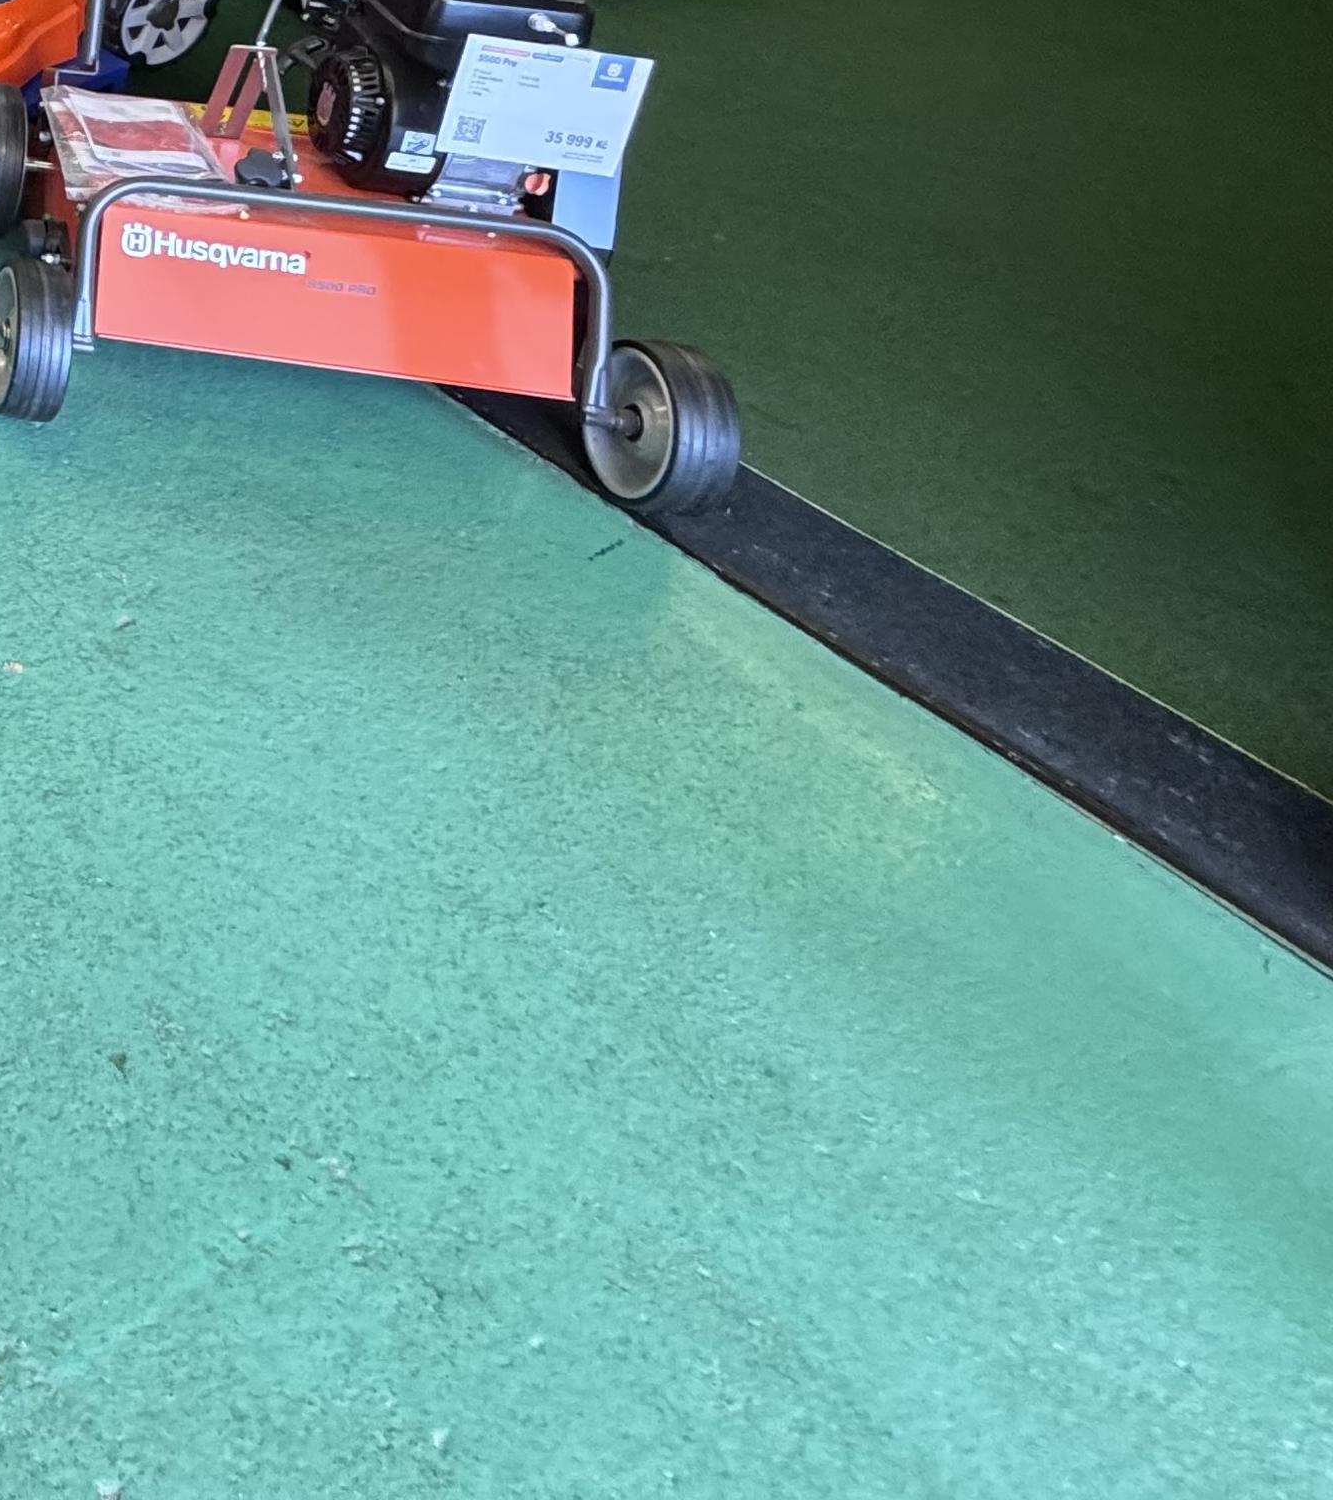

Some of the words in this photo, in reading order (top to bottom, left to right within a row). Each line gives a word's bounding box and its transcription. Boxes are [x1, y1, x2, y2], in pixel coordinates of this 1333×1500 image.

[544, 130, 563, 143] 35
[565, 133, 593, 149] 999
[154, 230, 306, 275] Husqvarna
